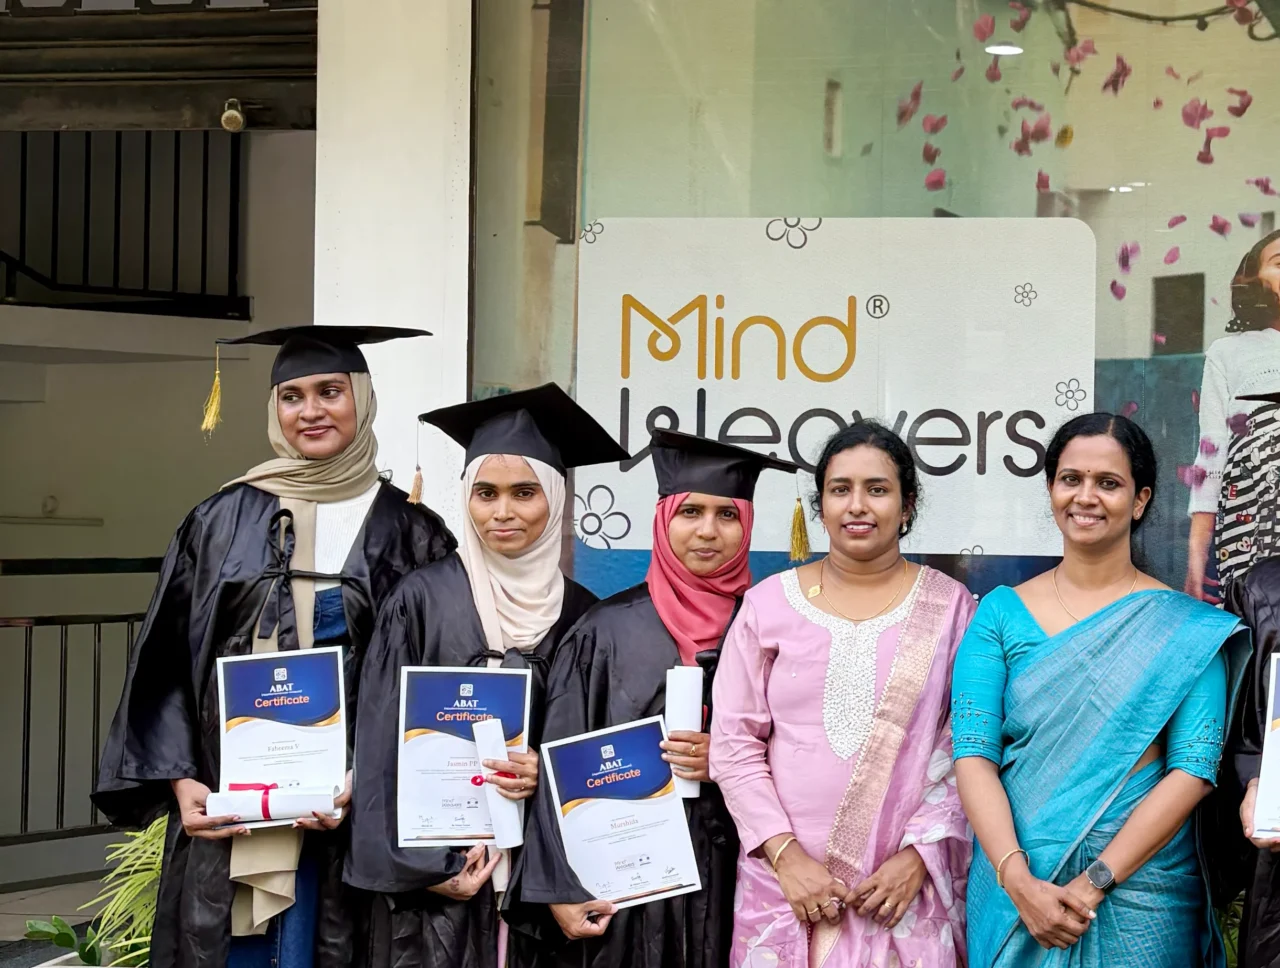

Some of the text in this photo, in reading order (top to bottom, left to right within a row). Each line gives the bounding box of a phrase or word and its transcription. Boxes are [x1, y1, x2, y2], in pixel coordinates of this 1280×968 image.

[620, 293, 858, 384] Mind
[269, 683, 294, 693] ABAT
[254, 695, 310, 708] Certificate
[453, 699, 479, 708] ABAT
[599, 758, 623, 772] ABAT
[586, 768, 641, 788] Certificate
